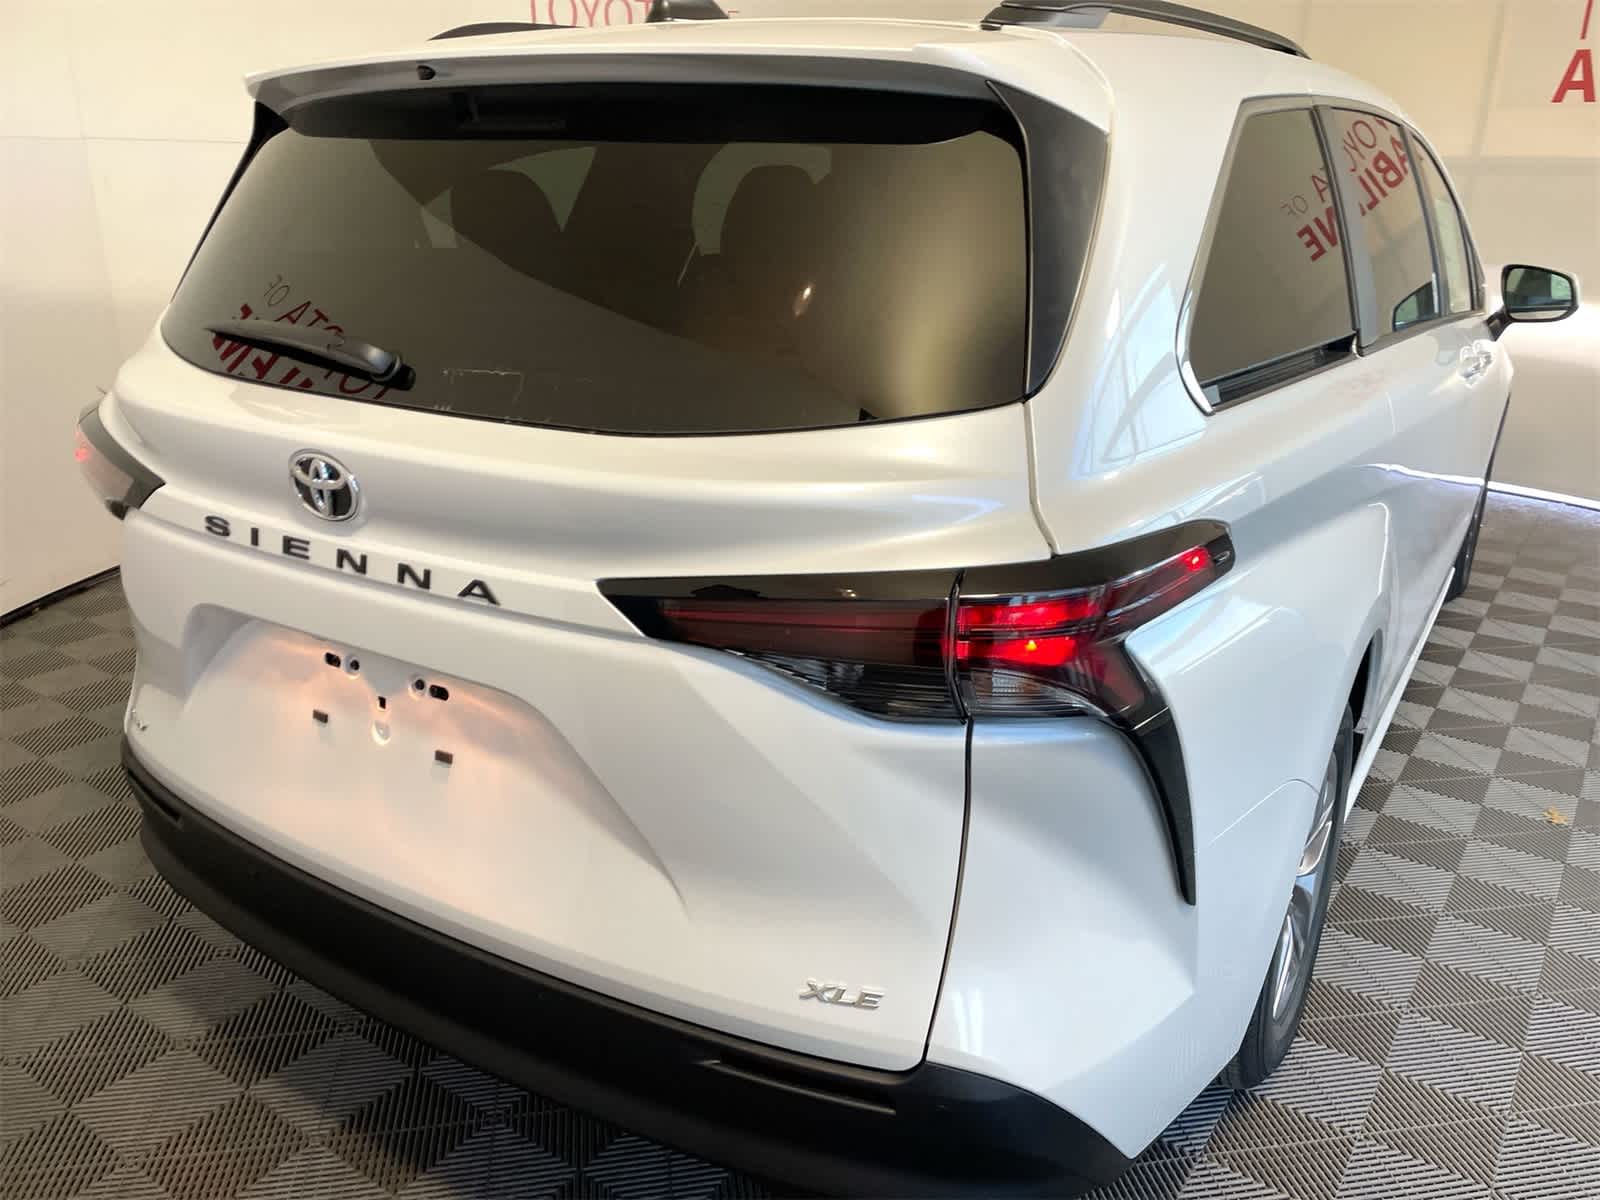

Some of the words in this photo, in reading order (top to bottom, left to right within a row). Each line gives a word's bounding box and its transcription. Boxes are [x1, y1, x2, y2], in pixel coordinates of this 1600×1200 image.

[528, 0, 651, 28] TOYOT
[204, 515, 501, 606] SIENNA
[798, 980, 884, 1011] XLE
